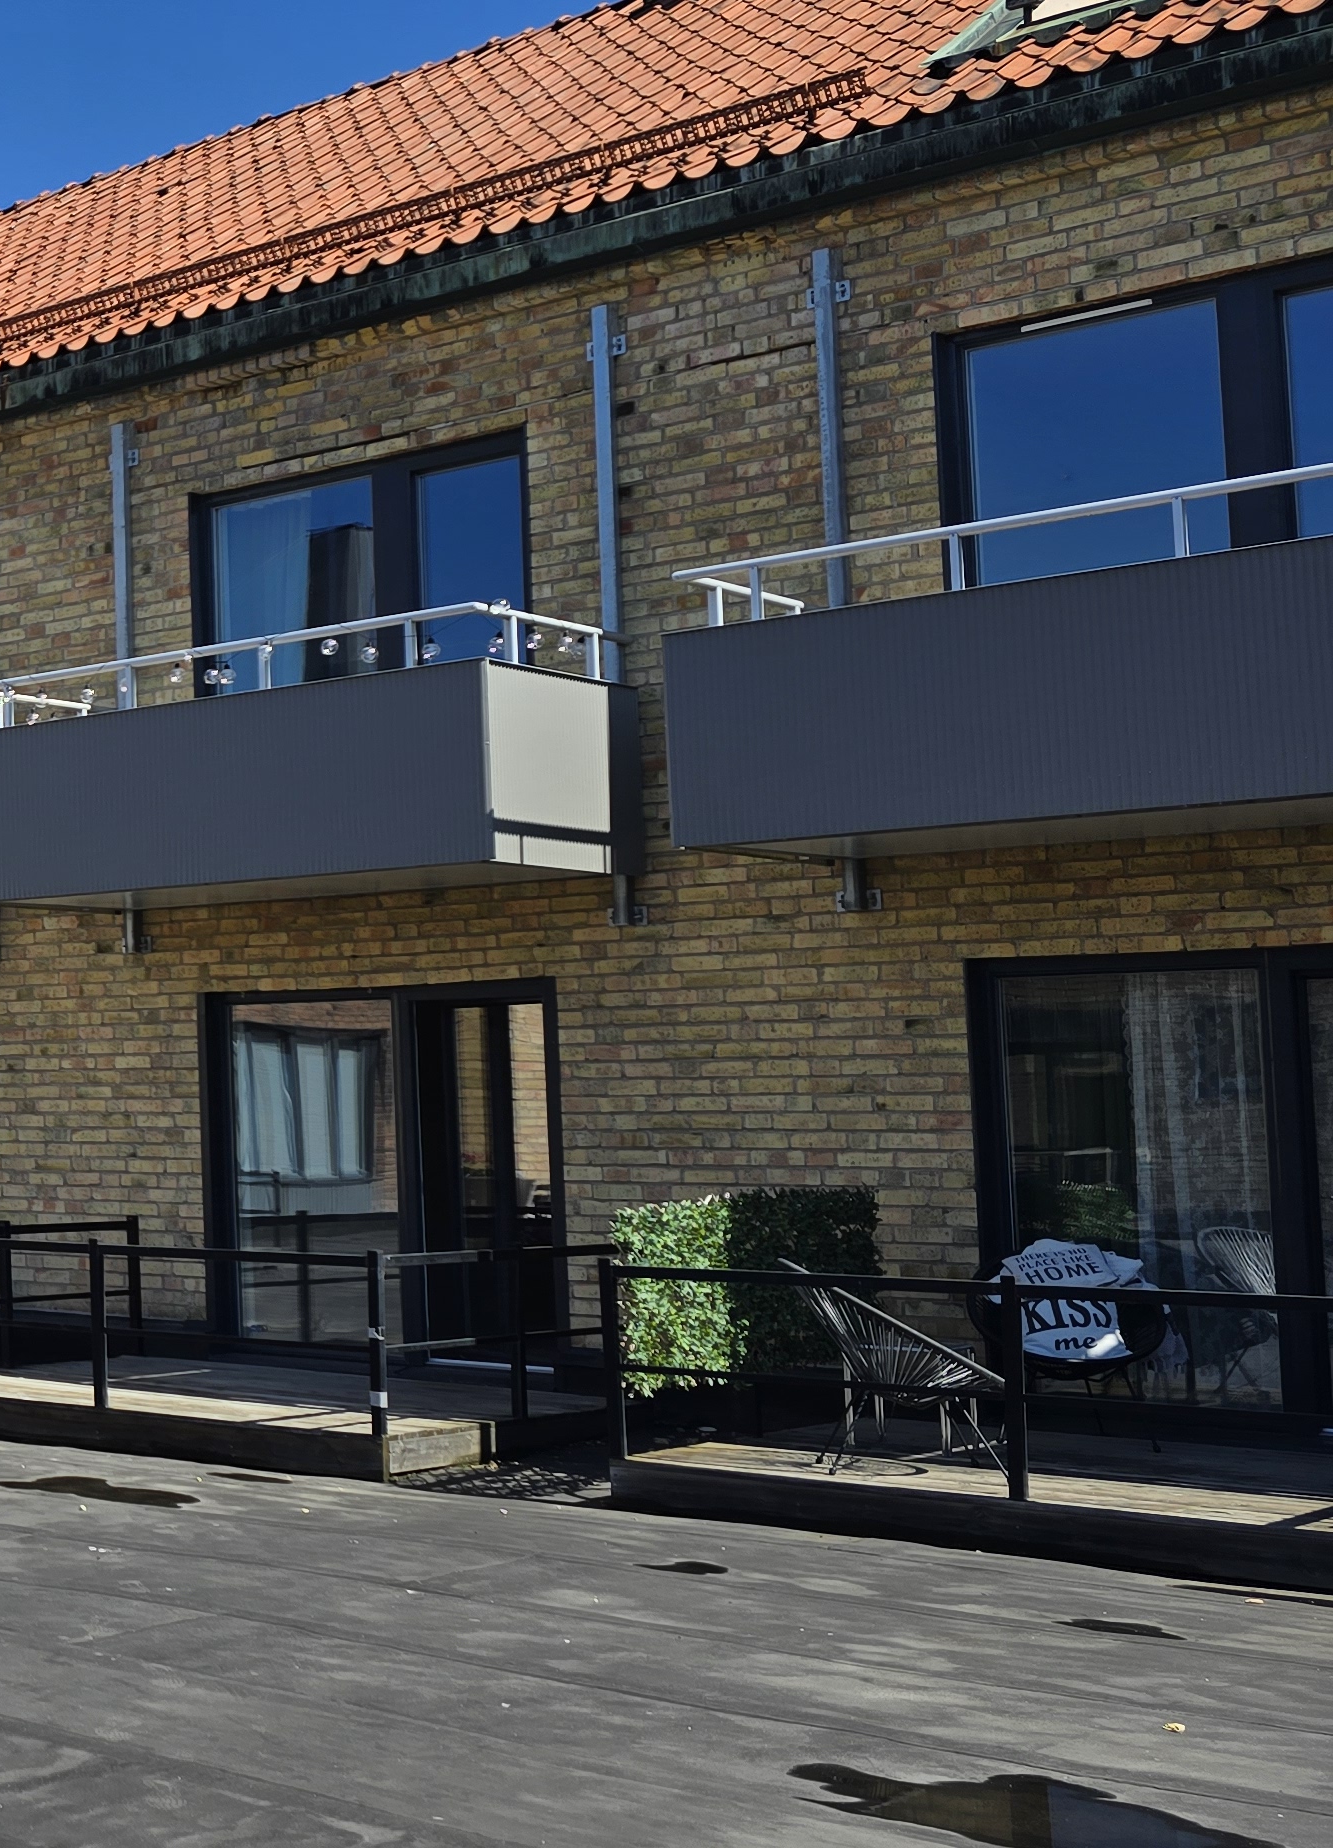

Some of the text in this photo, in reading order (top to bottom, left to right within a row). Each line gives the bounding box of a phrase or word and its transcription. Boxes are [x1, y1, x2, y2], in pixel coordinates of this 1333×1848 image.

[1015, 1252, 1051, 1264] THERE
[1068, 1247, 1087, 1255] NO
[1018, 1254, 1093, 1271] PLACE LIKE
[1024, 1262, 1103, 1284] HOME
[1021, 1299, 1112, 1335] KISS
[1055, 1337, 1098, 1350] me
